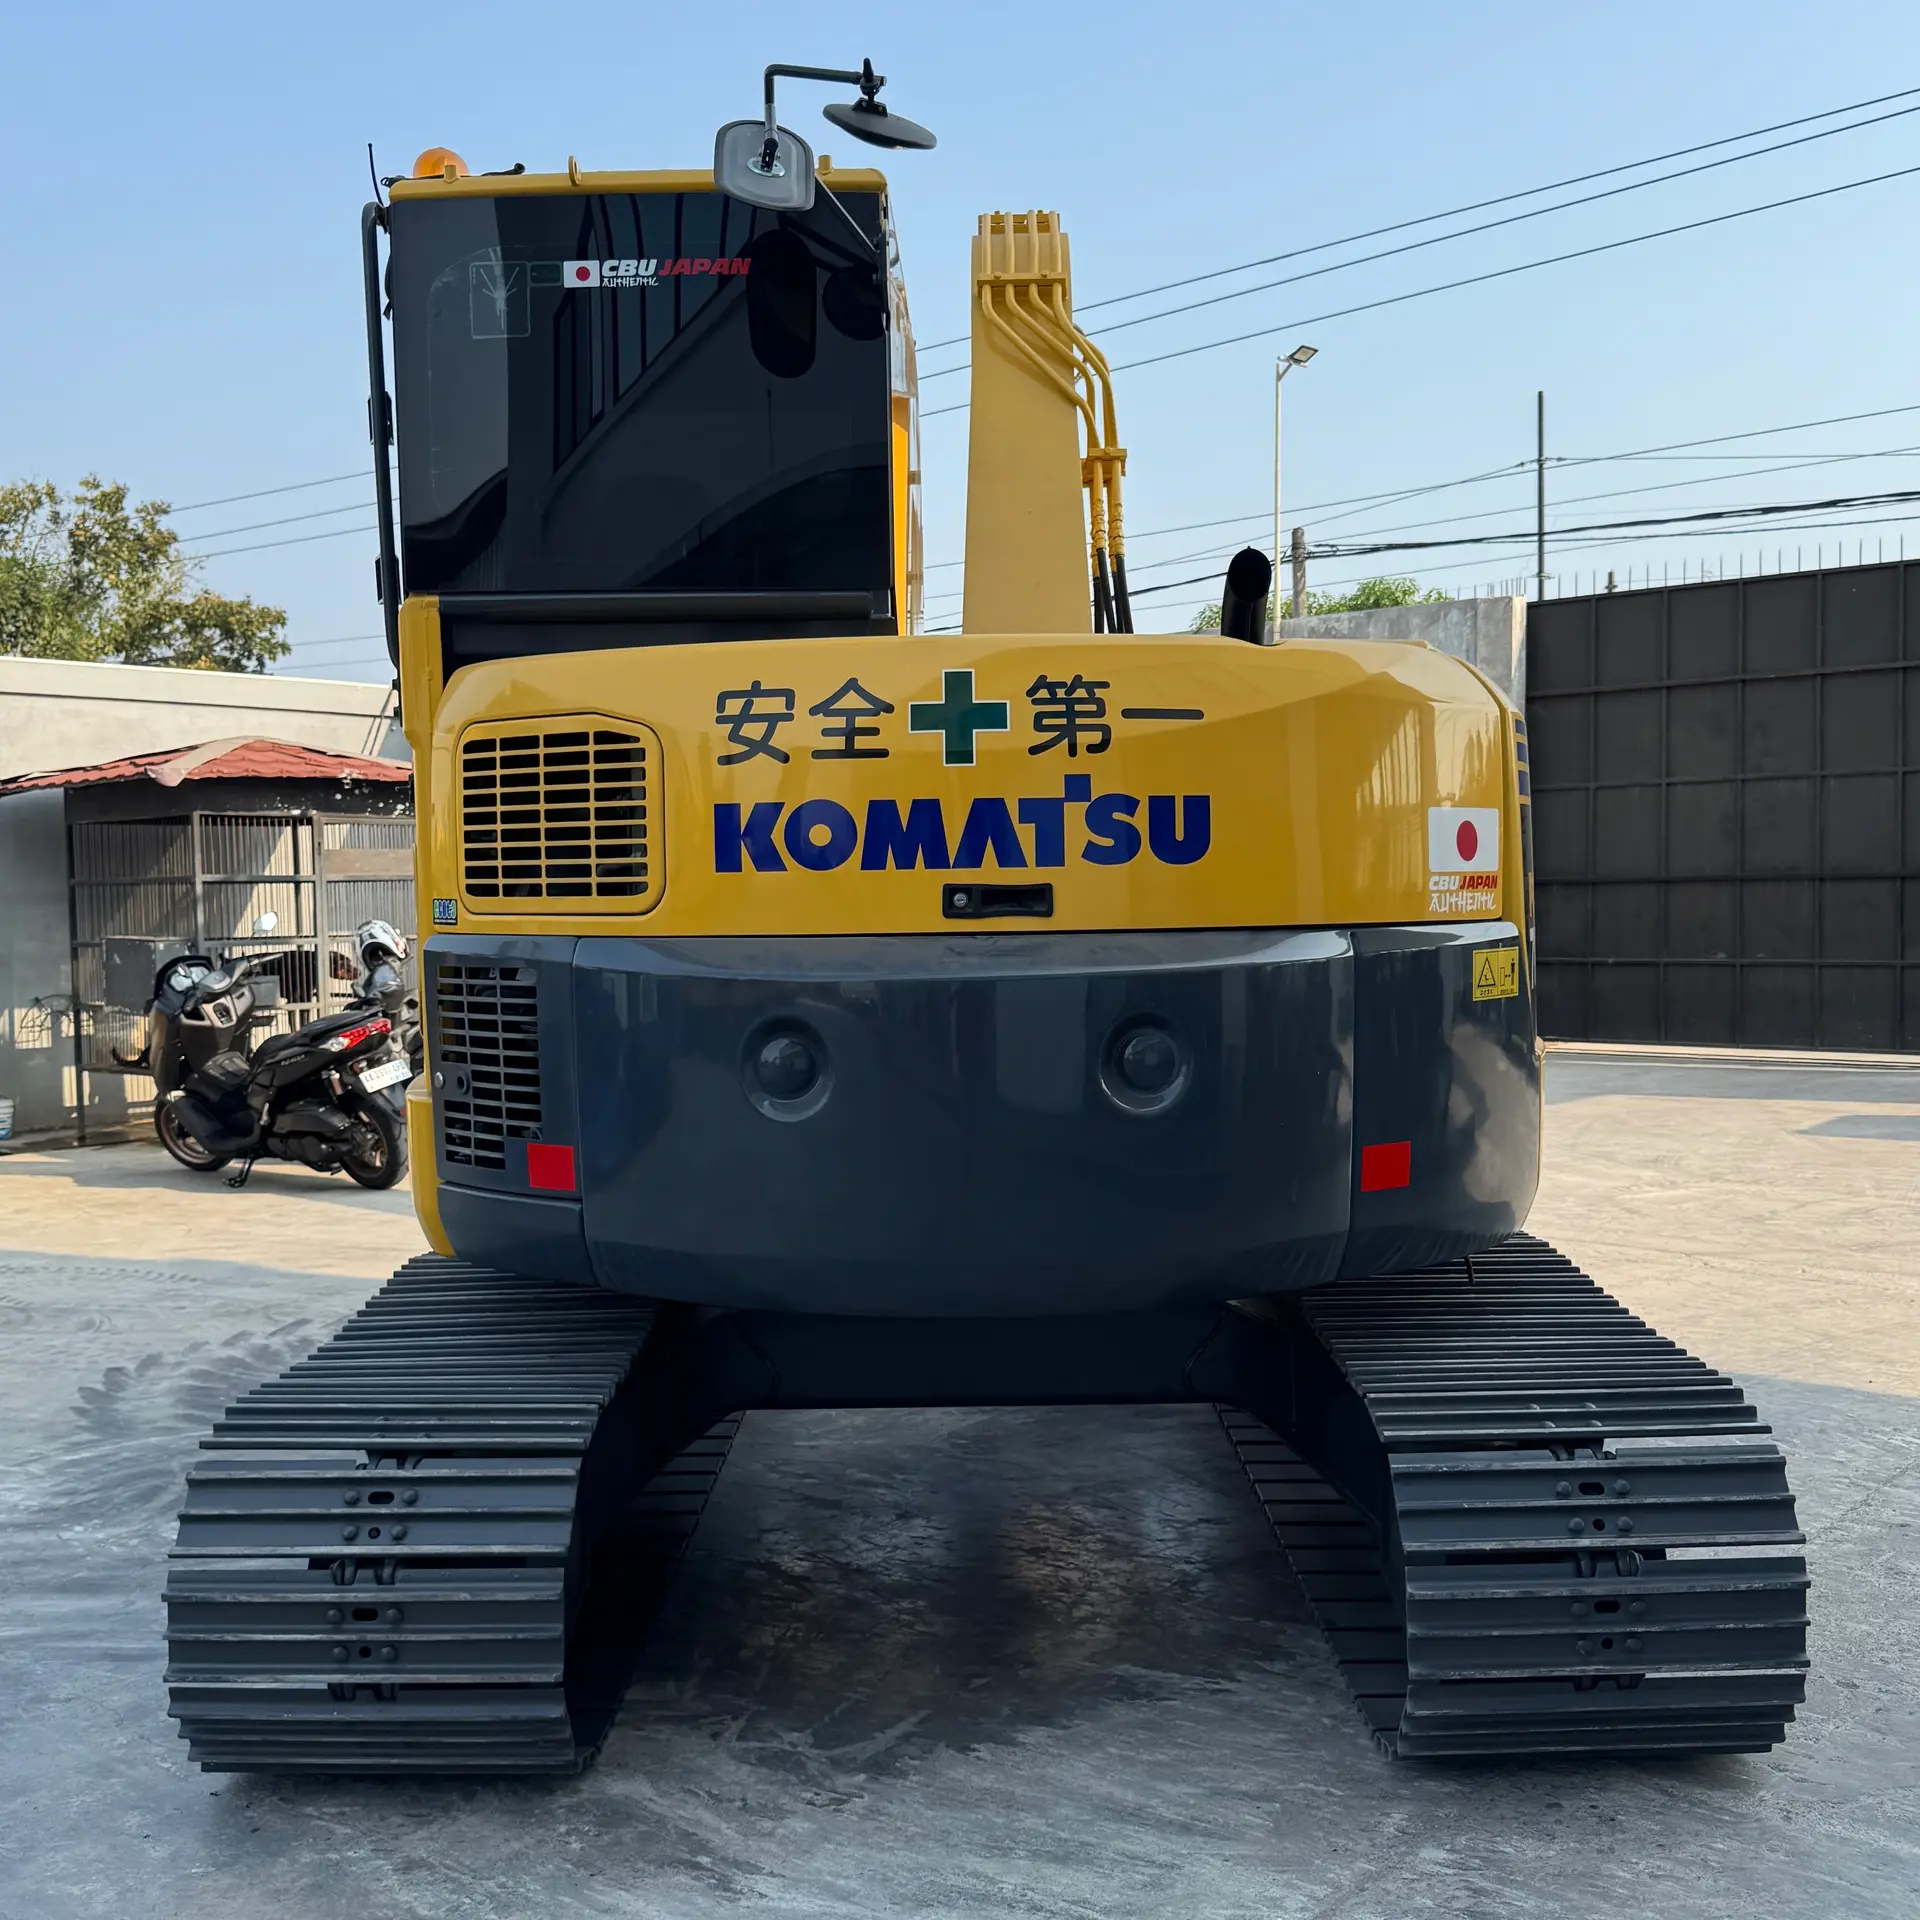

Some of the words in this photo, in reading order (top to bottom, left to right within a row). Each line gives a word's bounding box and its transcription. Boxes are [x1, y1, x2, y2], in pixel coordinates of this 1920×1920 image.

[601, 259, 658, 277] CBU
[658, 258, 751, 275] JAPAN
[601, 277, 659, 288] AUTHENTIC
[715, 677, 895, 766] 安全
[1025, 674, 1205, 758] 第一
[713, 773, 1211, 873] KOMATSU
[1429, 875, 1460, 891] CBU
[1460, 875, 1498, 890] JAPAN
